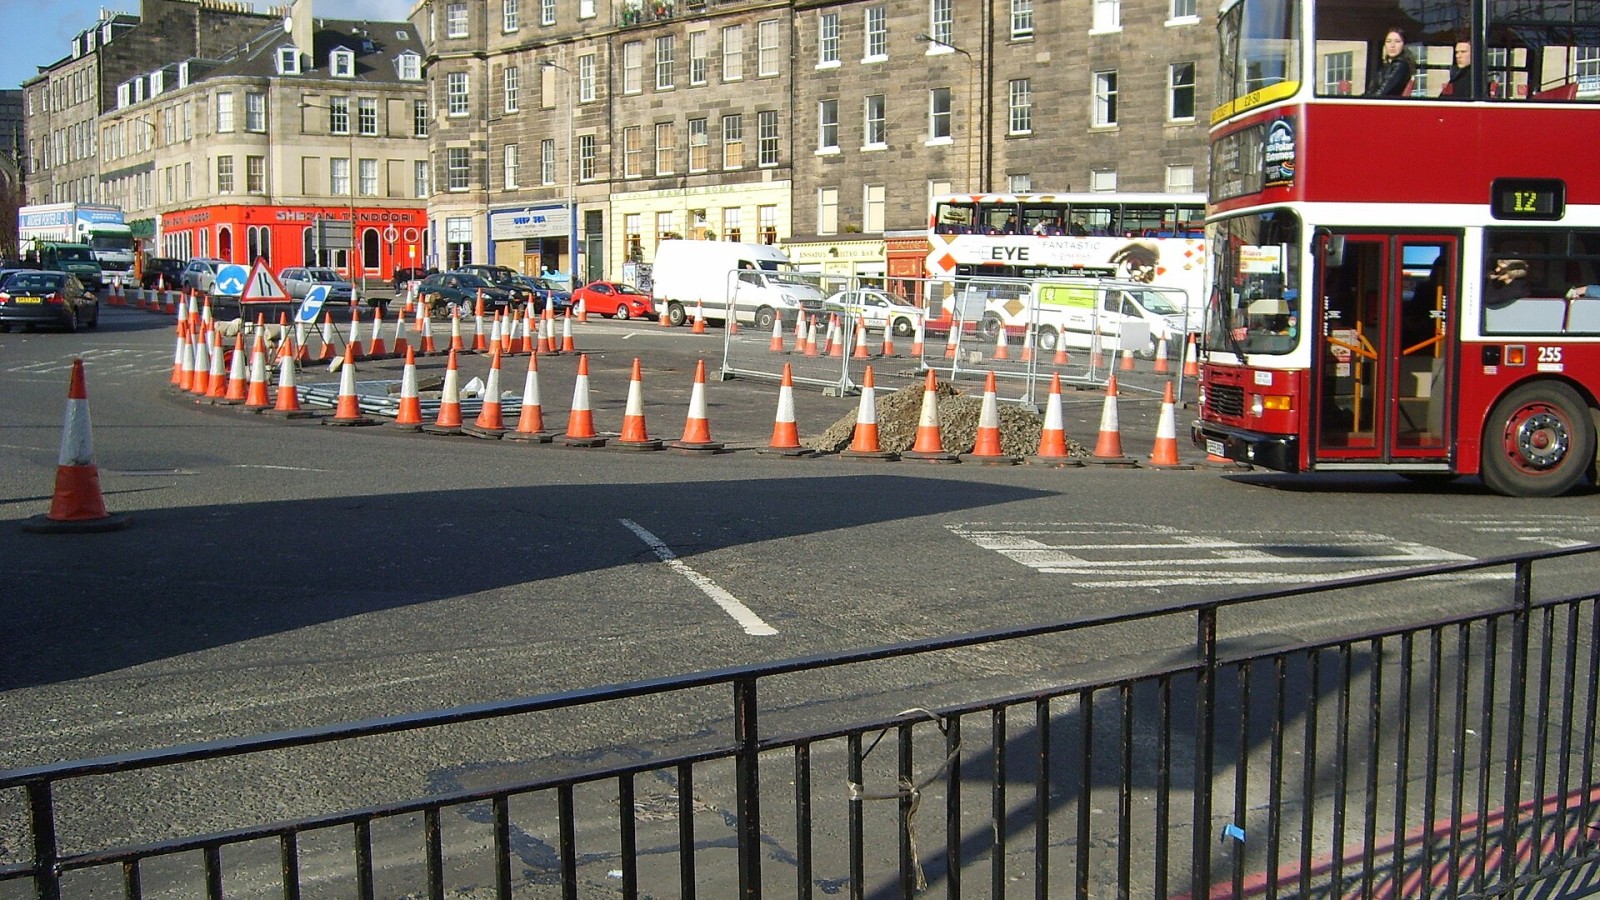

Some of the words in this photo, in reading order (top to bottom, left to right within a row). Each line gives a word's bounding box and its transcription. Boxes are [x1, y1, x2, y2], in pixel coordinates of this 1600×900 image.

[1275, 143, 1294, 152] Polar
[1514, 192, 1537, 211] 12
[341, 212, 413, 222] TANDOORI
[1042, 241, 1101, 250] FANTASTIC
[991, 246, 1030, 261] EYE
[1537, 346, 1562, 362] 255
